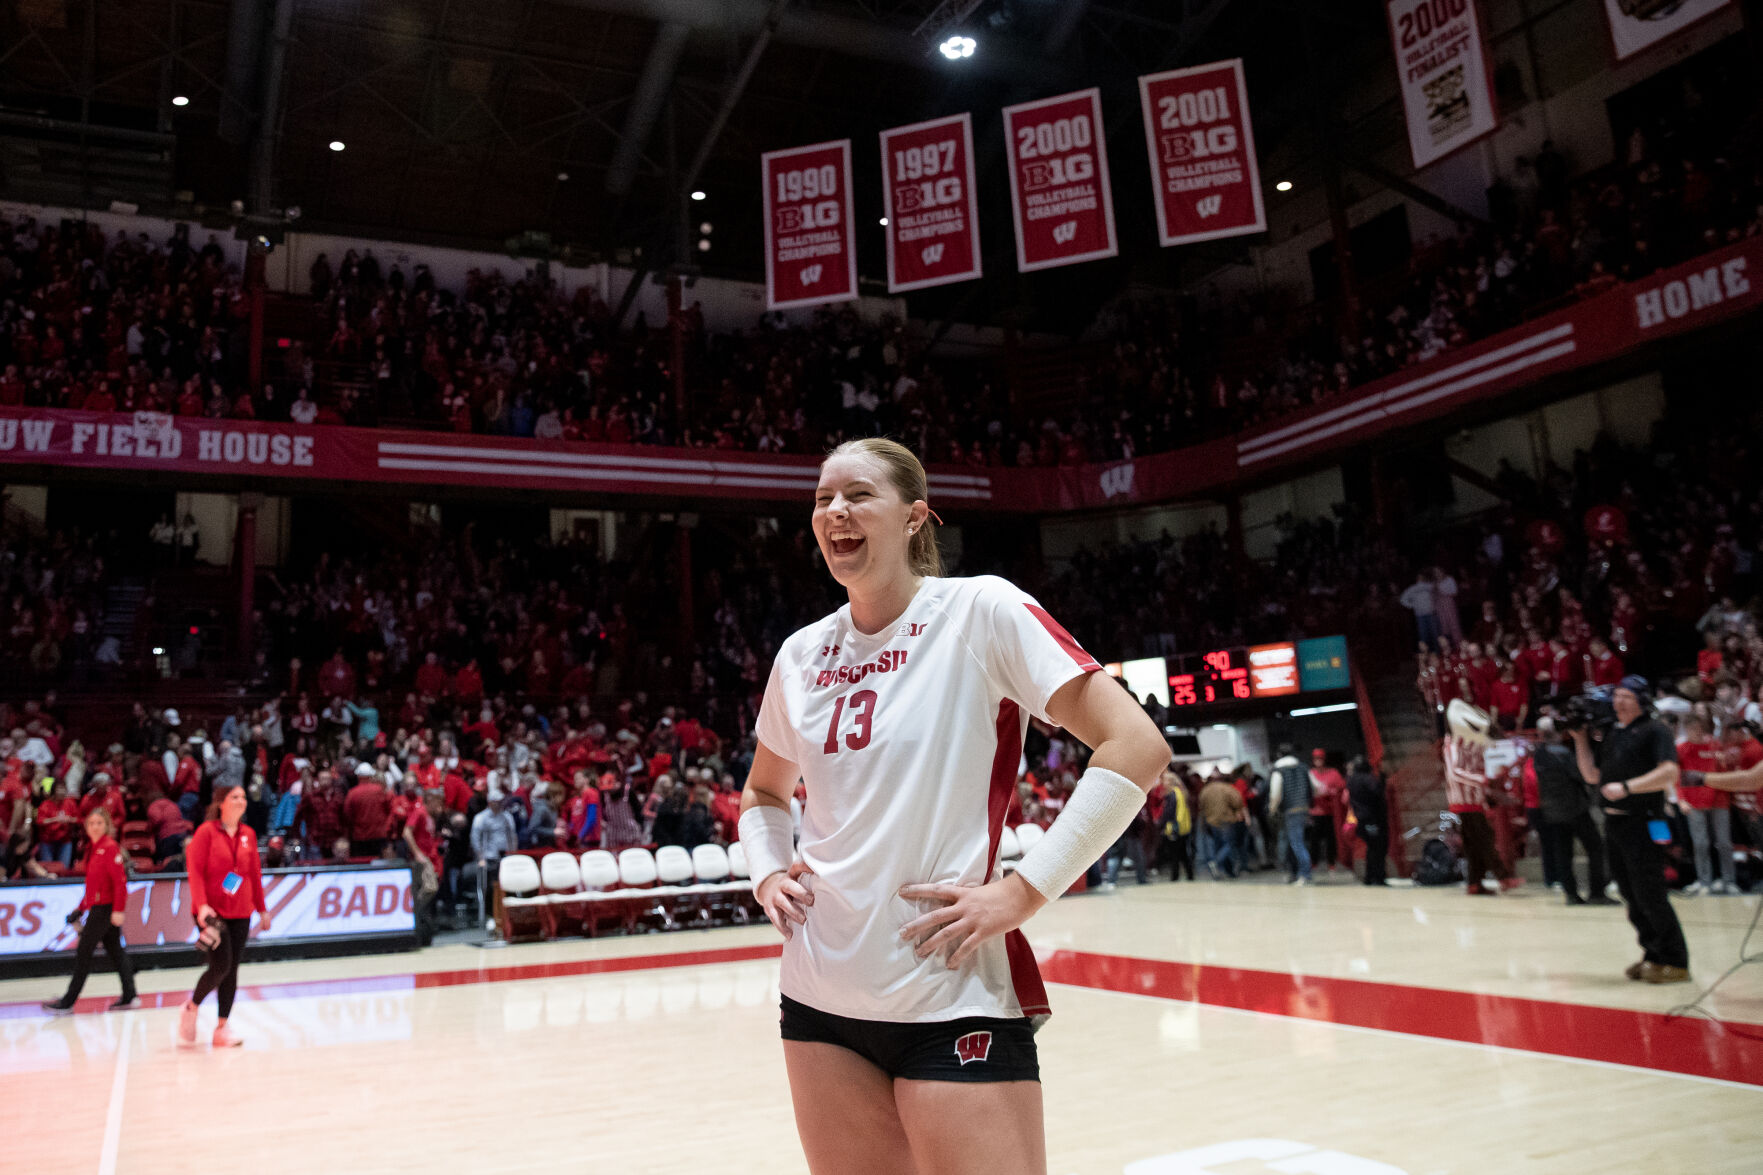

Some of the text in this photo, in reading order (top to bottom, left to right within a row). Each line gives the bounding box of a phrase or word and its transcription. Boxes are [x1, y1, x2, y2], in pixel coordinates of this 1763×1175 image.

[1158, 86, 1231, 130] 2001
[1017, 114, 1092, 160] 2000
[895, 139, 957, 182] 1997
[1168, 169, 1243, 193] CHAMPIONS
[776, 164, 837, 203] 1990
[1027, 196, 1098, 222] CHAMPIONS
[898, 218, 965, 243] CHAMPIONS
[777, 241, 842, 262] CHAMPIONS
[1635, 255, 1751, 328] HOME
[0, 418, 55, 451] UW
[199, 430, 314, 466] HOUSE
[1174, 684, 1197, 705] 25
[824, 690, 878, 754] 13
